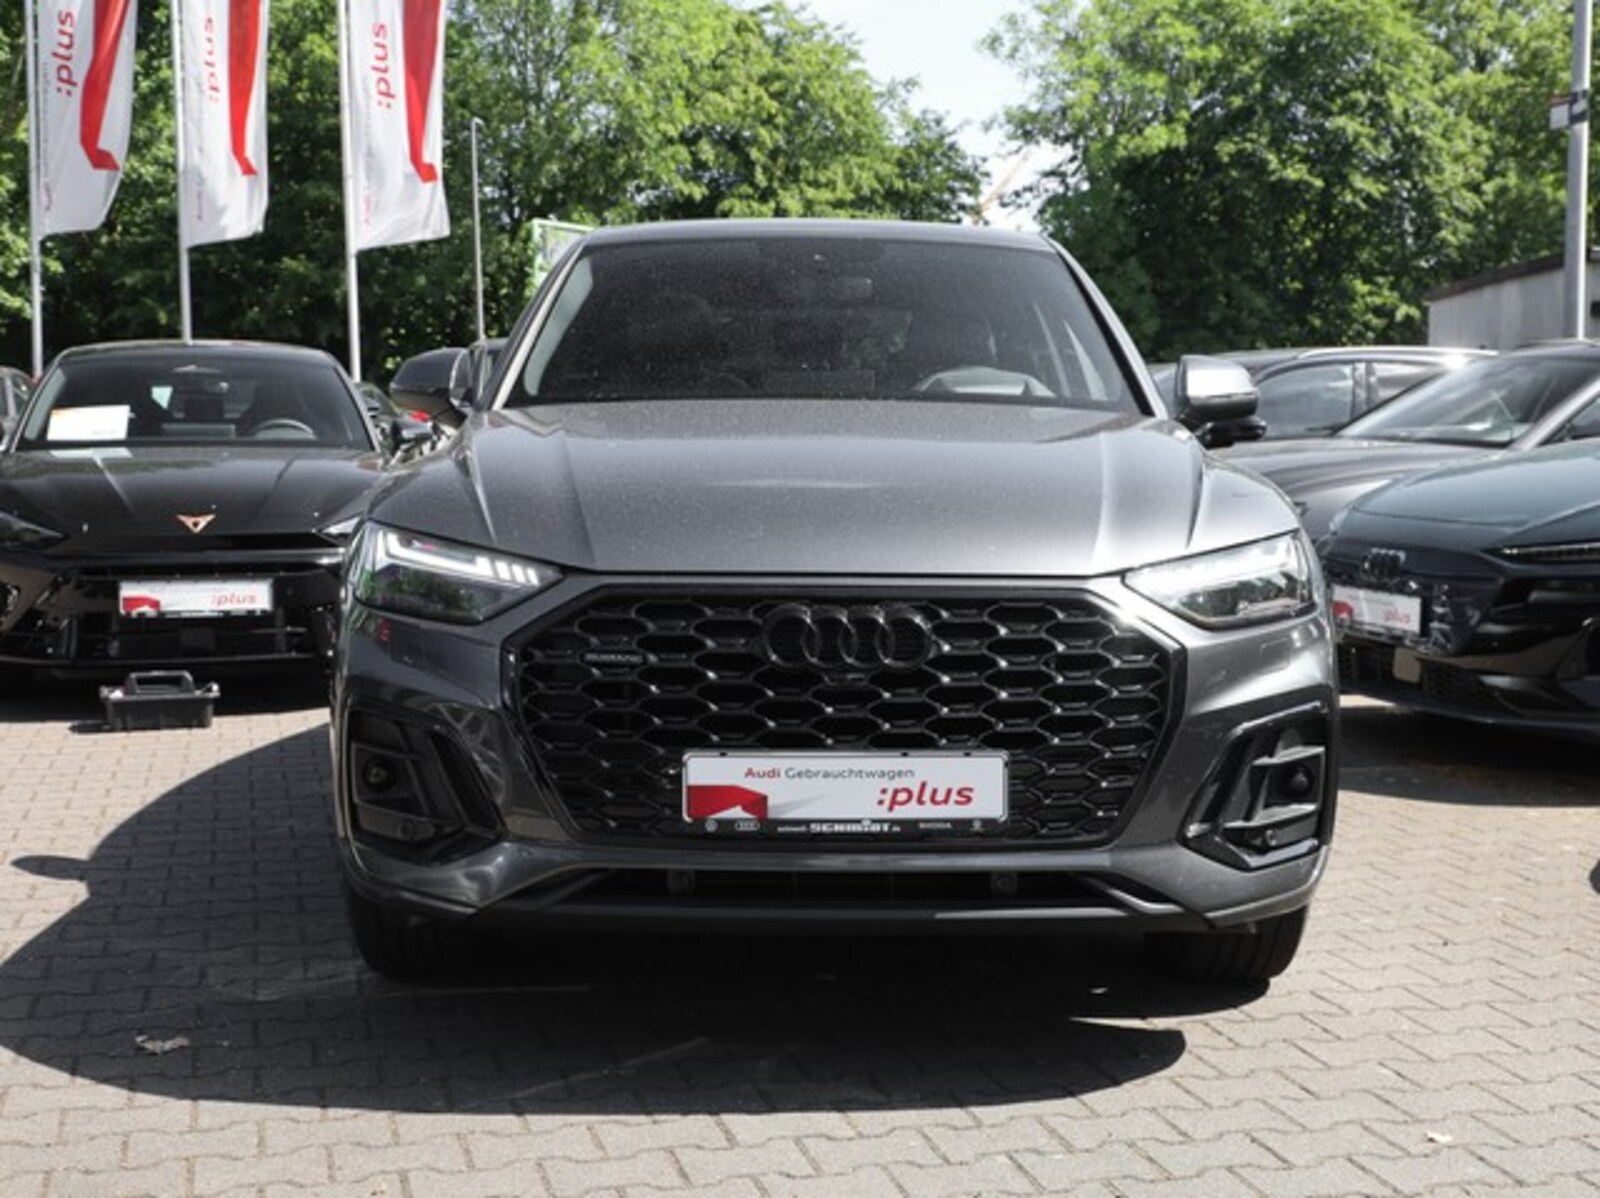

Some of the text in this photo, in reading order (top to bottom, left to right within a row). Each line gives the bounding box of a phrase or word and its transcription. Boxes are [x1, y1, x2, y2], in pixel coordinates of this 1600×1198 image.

[51, 10, 78, 97] :plus
[371, 22, 396, 109] :plus
[744, 767, 915, 780] Audi Gebrauchtwagen
[877, 780, 975, 812] :plus
